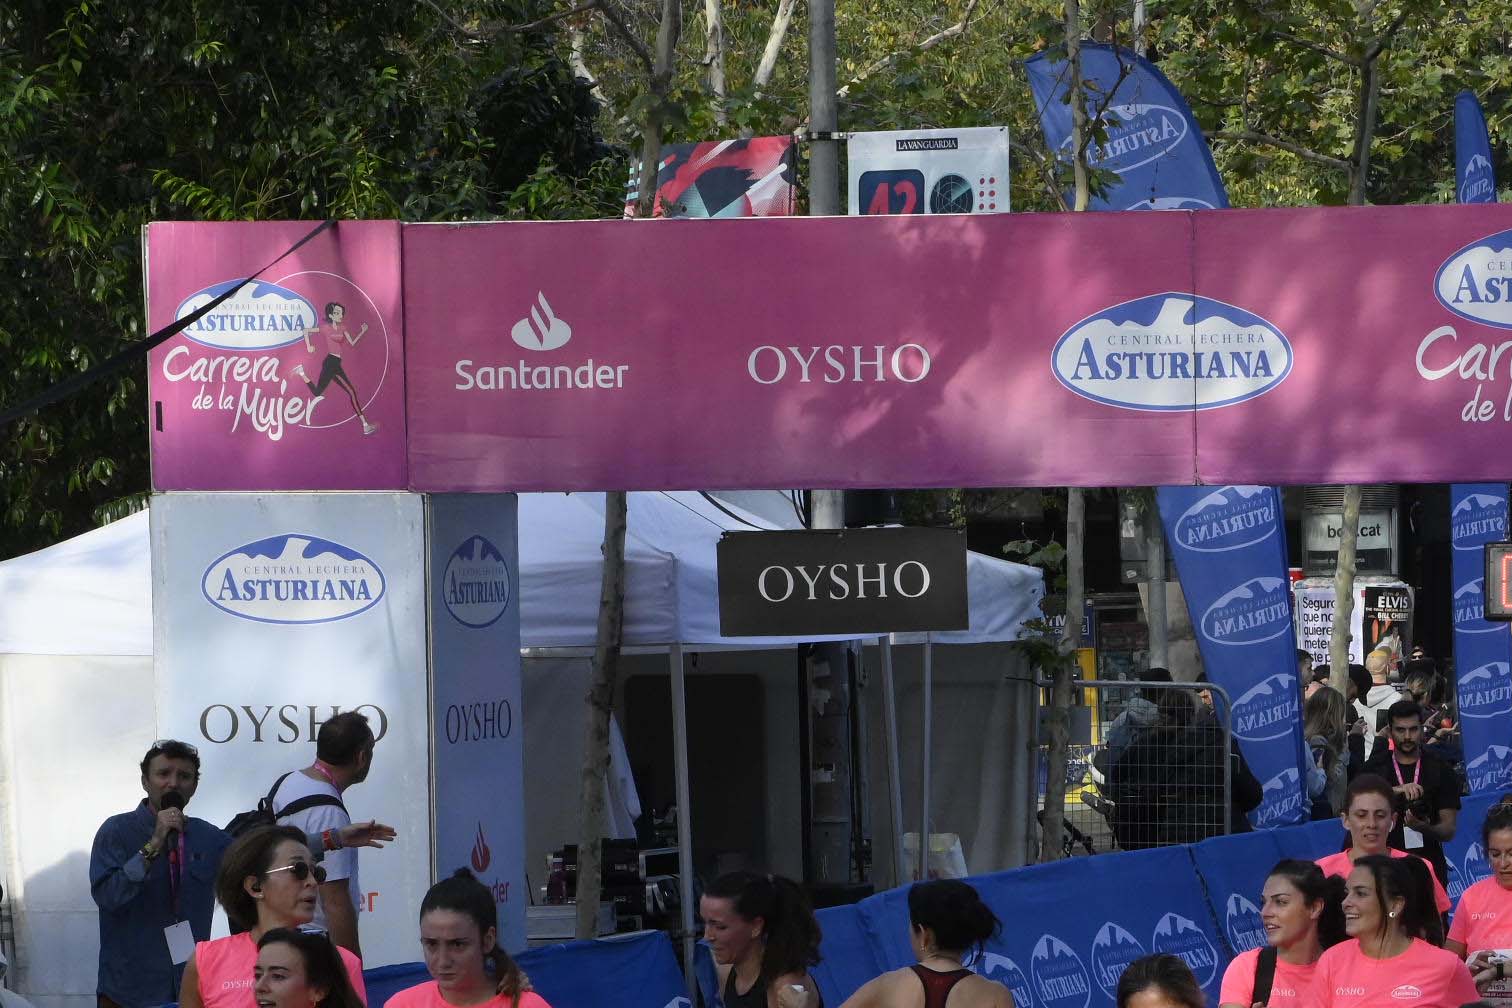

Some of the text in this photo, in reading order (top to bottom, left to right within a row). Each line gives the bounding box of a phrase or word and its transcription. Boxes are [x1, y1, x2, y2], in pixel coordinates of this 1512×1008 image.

[1107, 332, 1267, 347] CENTRAL LECHERA
[163, 346, 280, 383] Carrera
[455, 360, 629, 391] Santander
[747, 343, 932, 385] OYSHO
[1071, 338, 1275, 382] ASTURIANA
[192, 380, 325, 441] de la Mujer
[1461, 386, 1496, 423] de
[217, 568, 373, 602] ASTURIANA
[244, 565, 366, 575] CENTRAL LECHERA
[449, 568, 505, 606] ASTURIANA
[758, 560, 930, 602] OYSHO
[1303, 613, 1319, 625] que
[1378, 596, 1408, 608] ELVIS
[1304, 625, 1333, 640] quiere
[446, 700, 511, 743] OYSHO
[222, 979, 256, 991] OYSH
[1037, 970, 1087, 1001] ASTURIANA
